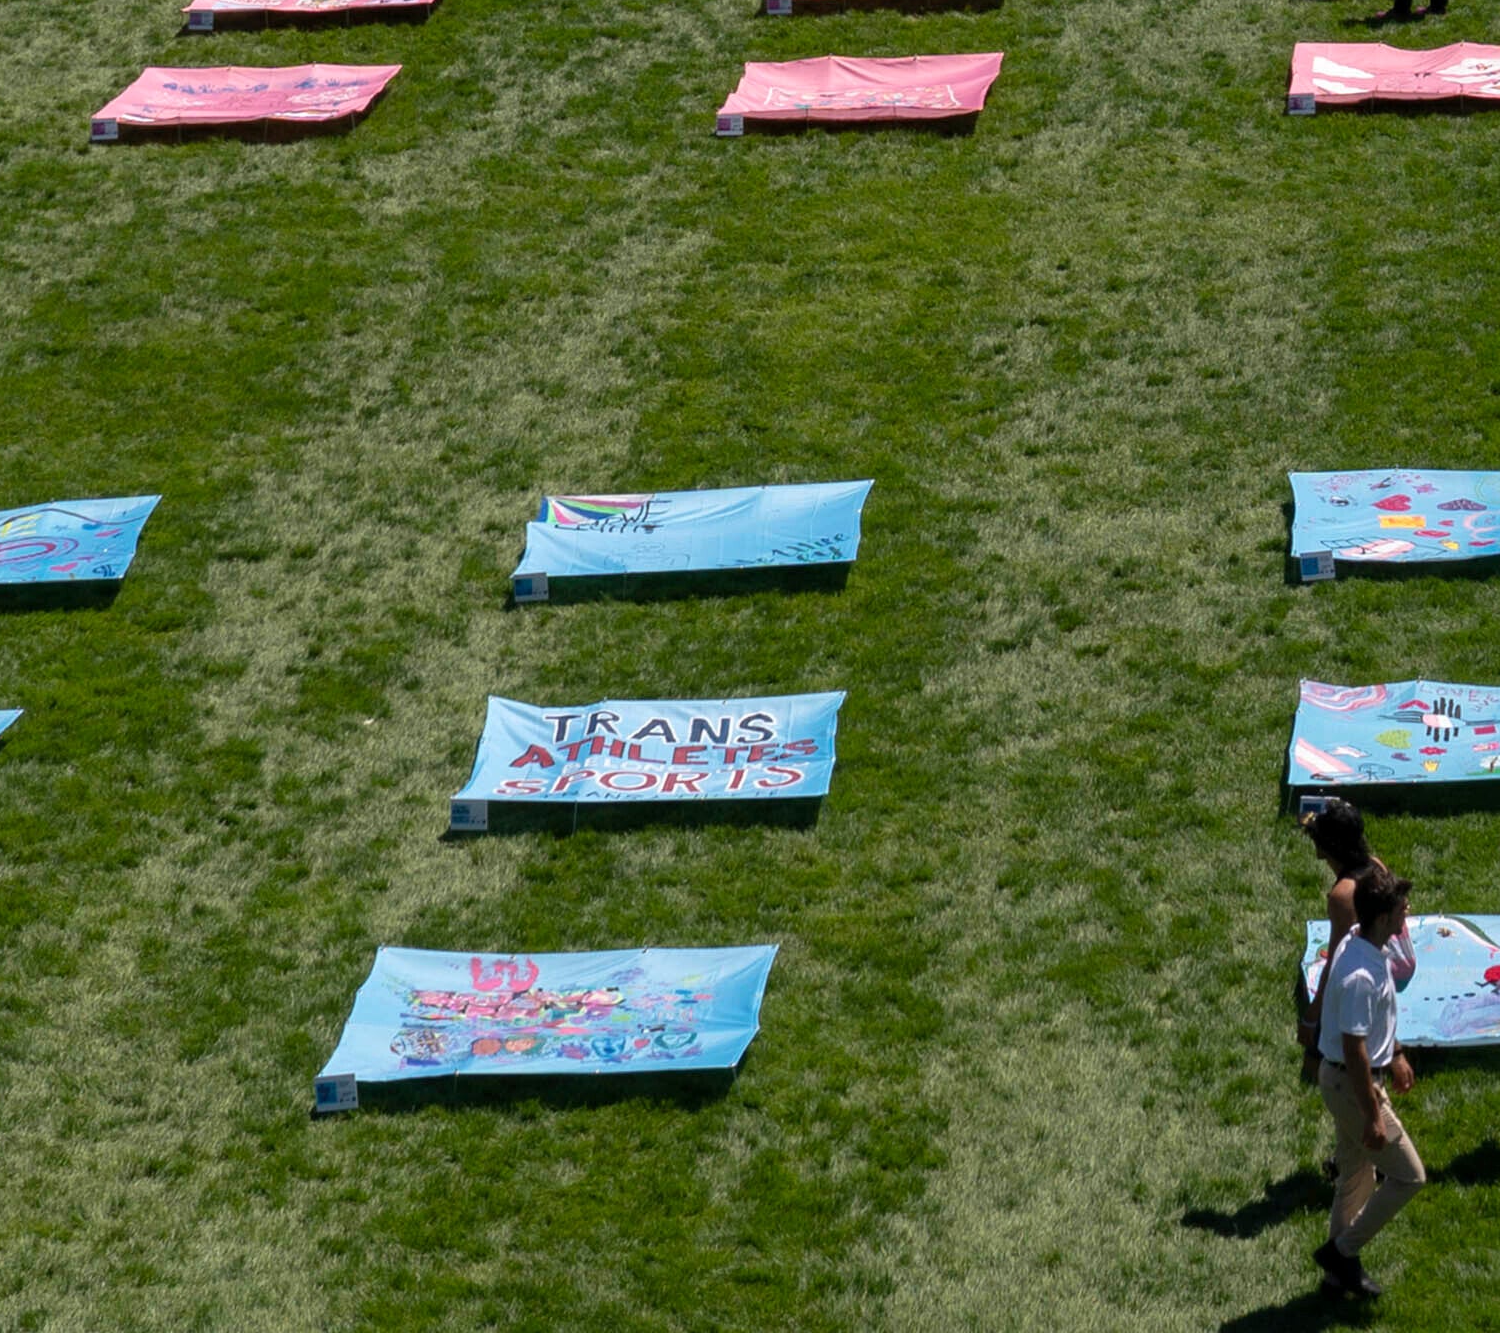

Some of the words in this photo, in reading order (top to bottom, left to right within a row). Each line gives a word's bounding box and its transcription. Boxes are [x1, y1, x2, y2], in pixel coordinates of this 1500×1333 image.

[544, 710, 775, 745] TRANS
[509, 736, 820, 769] ATHLETES
[494, 765, 804, 795] SPORTS
